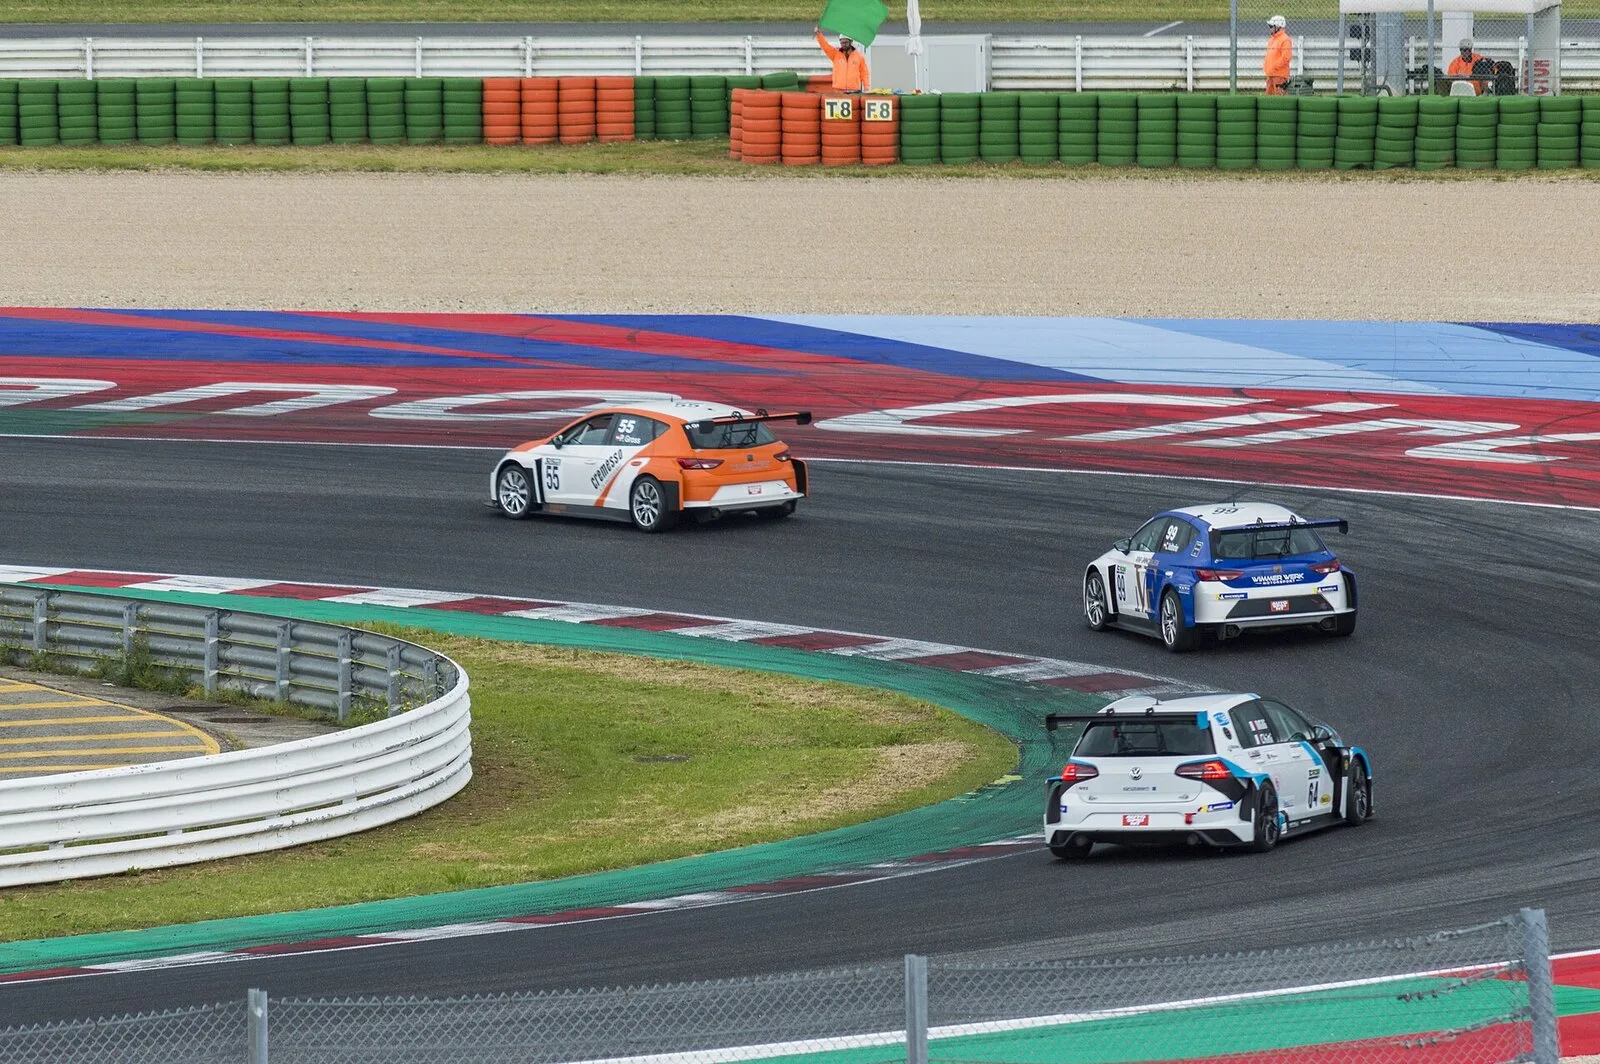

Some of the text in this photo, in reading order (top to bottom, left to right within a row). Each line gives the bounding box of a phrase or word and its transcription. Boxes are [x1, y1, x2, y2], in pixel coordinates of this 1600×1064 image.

[618, 419, 636, 434] 55
[546, 466, 560, 490] 55
[590, 449, 623, 490] cremesso
[1165, 525, 1178, 541] 99
[1117, 574, 1126, 601] 99
[1307, 781, 1319, 809] 64
